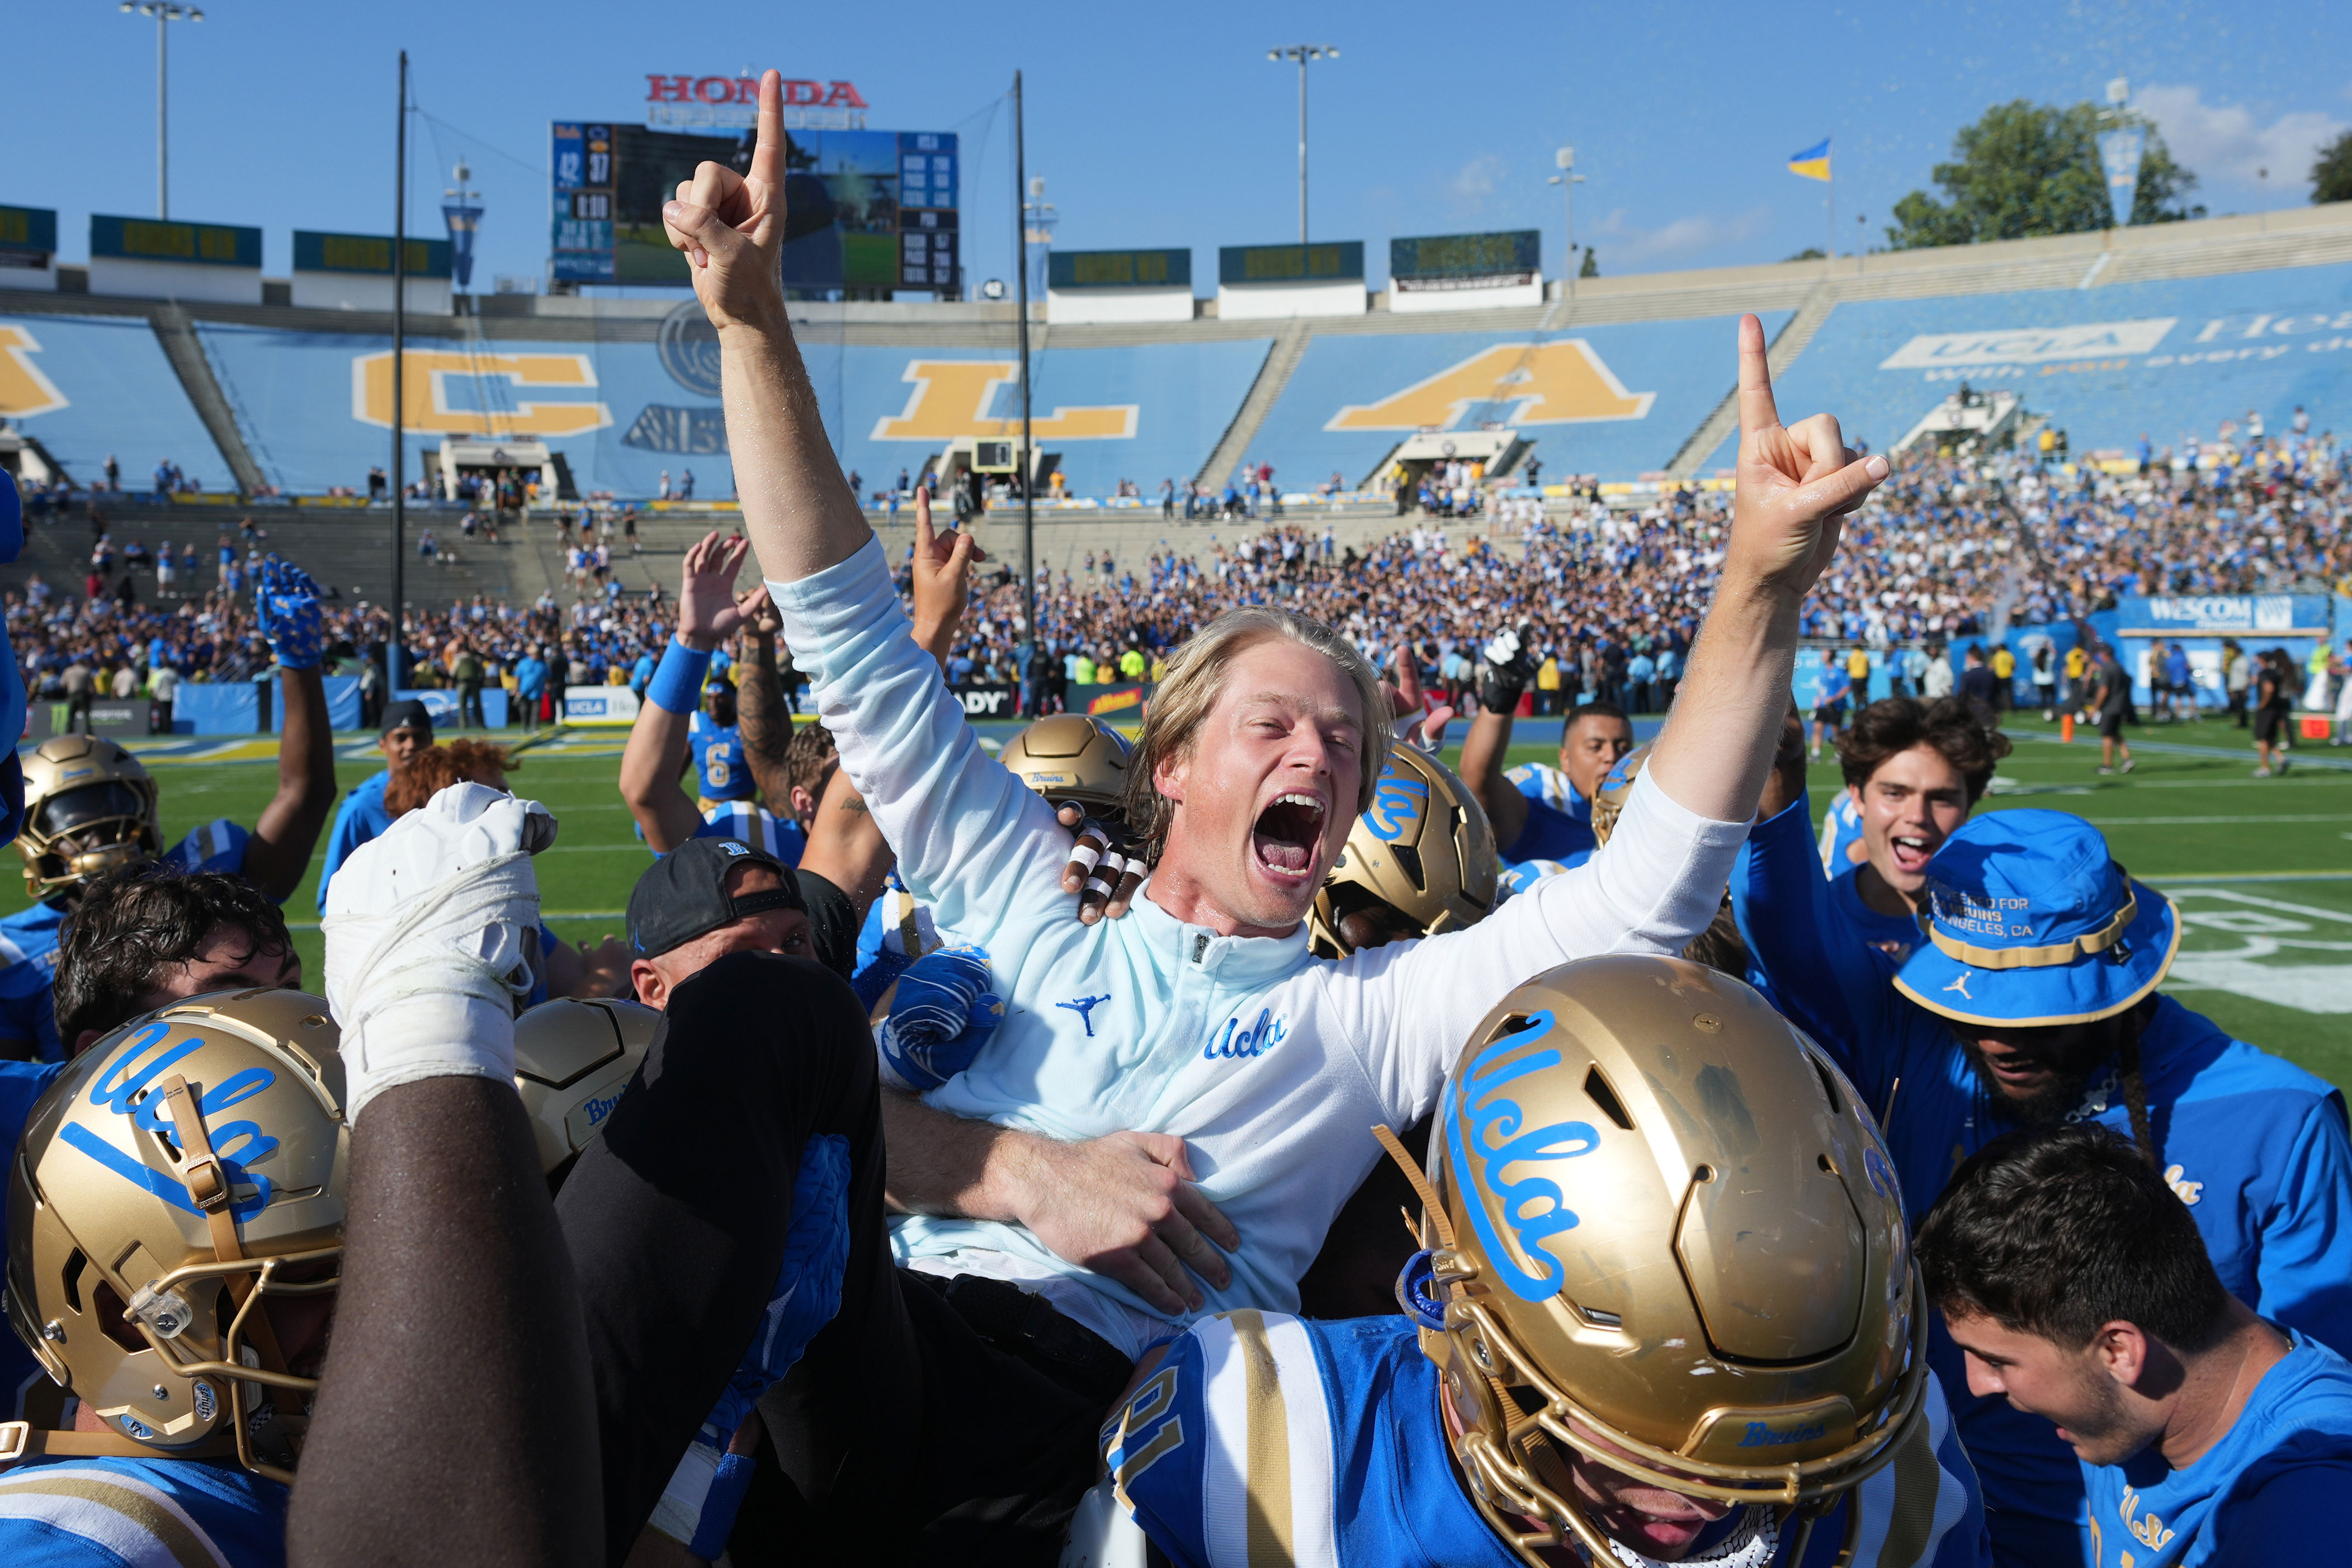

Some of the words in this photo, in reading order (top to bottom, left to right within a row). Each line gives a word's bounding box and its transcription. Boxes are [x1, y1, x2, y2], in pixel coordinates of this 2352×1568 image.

[646, 74, 868, 108] HONDA
[2150, 596, 2252, 621] WESCOM
[568, 700, 604, 714] UCLA
[706, 743, 730, 788] 6
[1031, 772, 1064, 782] Bruins
[718, 842, 750, 856] B
[1999, 898, 2029, 910] FOR
[2011, 925, 2034, 937] CA
[58, 1022, 278, 1224] Ucla
[1445, 1009, 1601, 1302] Ucla
[1737, 1422, 1827, 1447] Bruins
